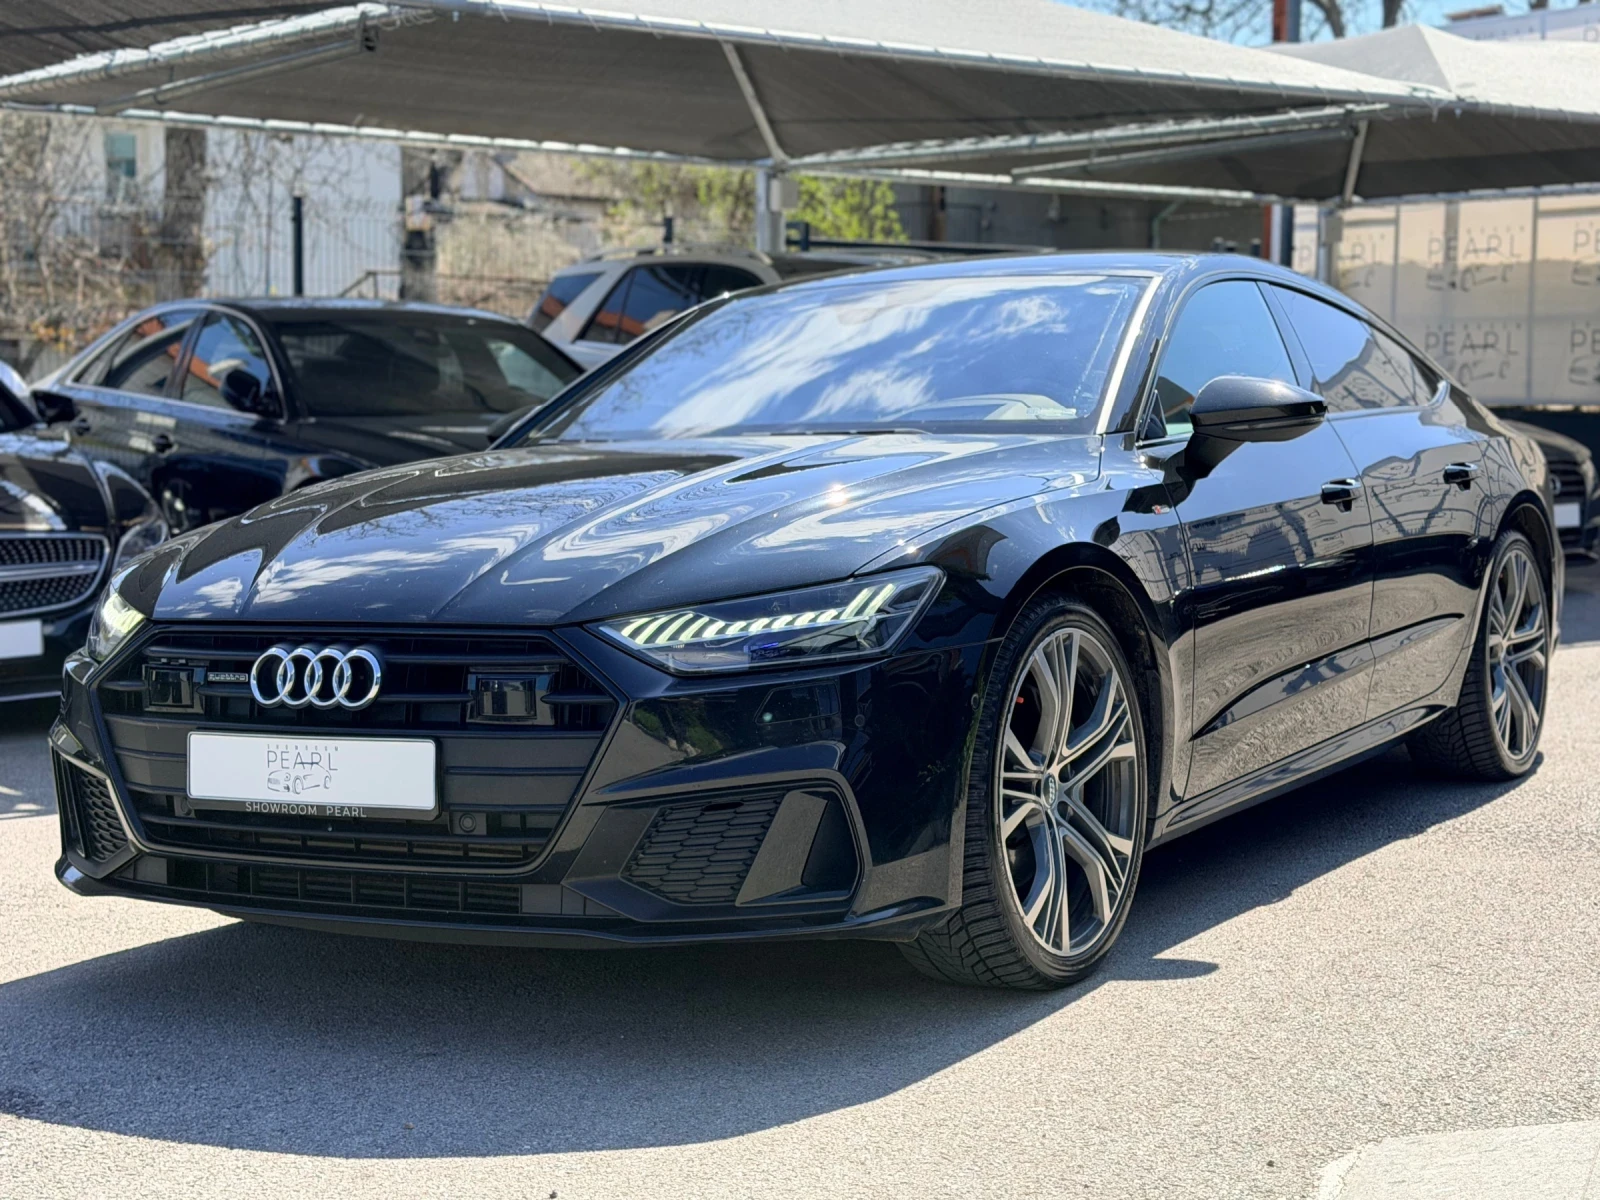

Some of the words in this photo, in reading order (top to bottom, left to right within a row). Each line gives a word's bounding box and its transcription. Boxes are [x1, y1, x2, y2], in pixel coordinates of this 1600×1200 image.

[1424, 330, 1519, 356] PEARL
[266, 750, 338, 771] PEARL
[245, 801, 318, 816] SHOWROOM
[326, 805, 367, 818] PEARL
